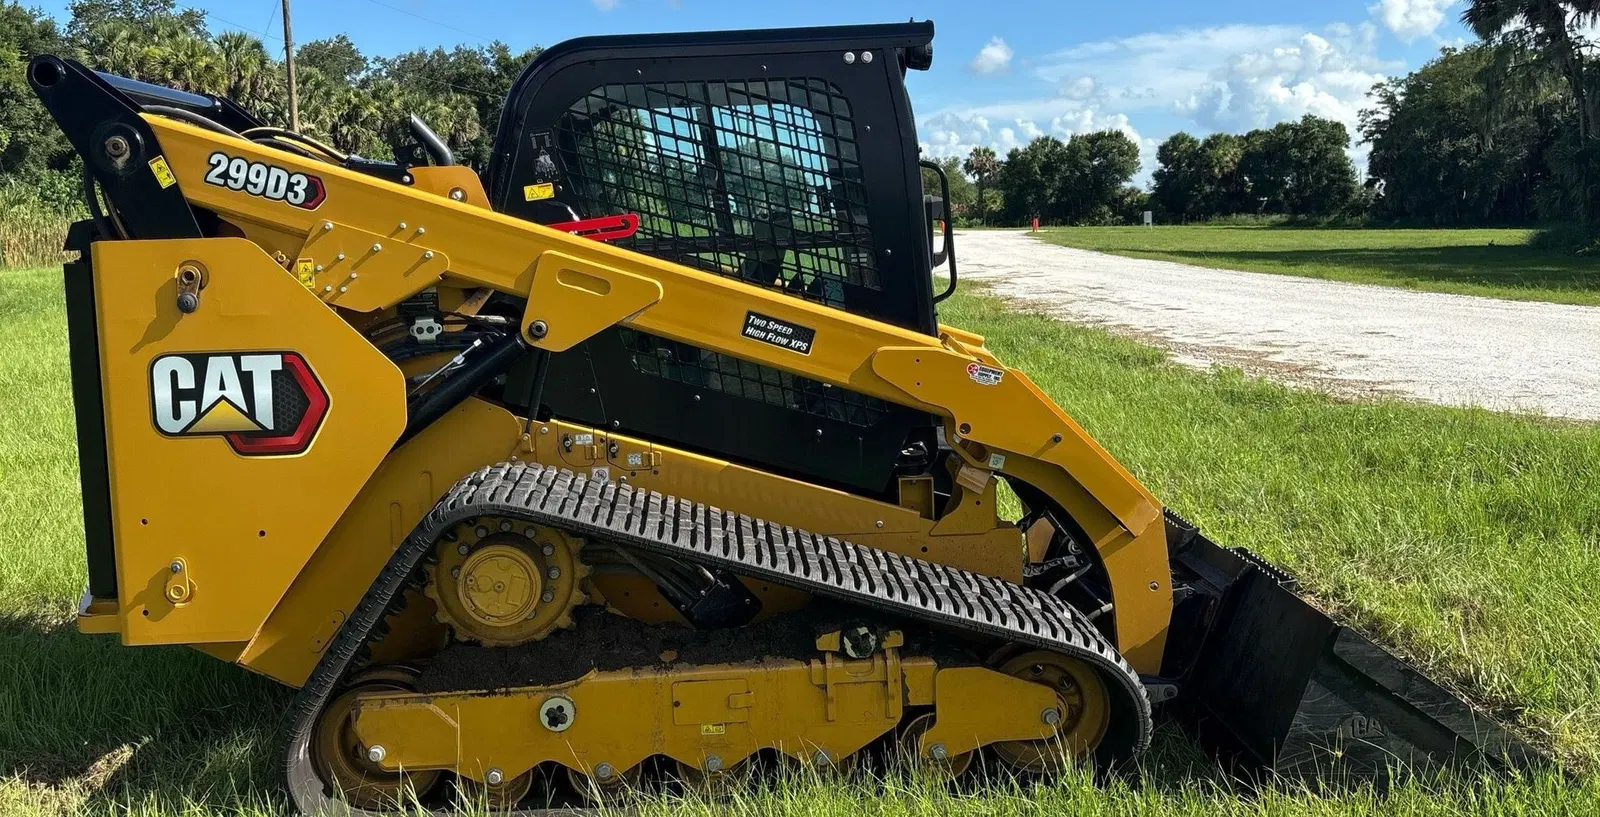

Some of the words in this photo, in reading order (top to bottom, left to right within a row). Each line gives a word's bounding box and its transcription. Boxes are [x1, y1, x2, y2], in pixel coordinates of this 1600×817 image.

[206, 152, 309, 205] 299D3
[789, 339, 809, 351] XPS
[153, 354, 283, 433] CAT
